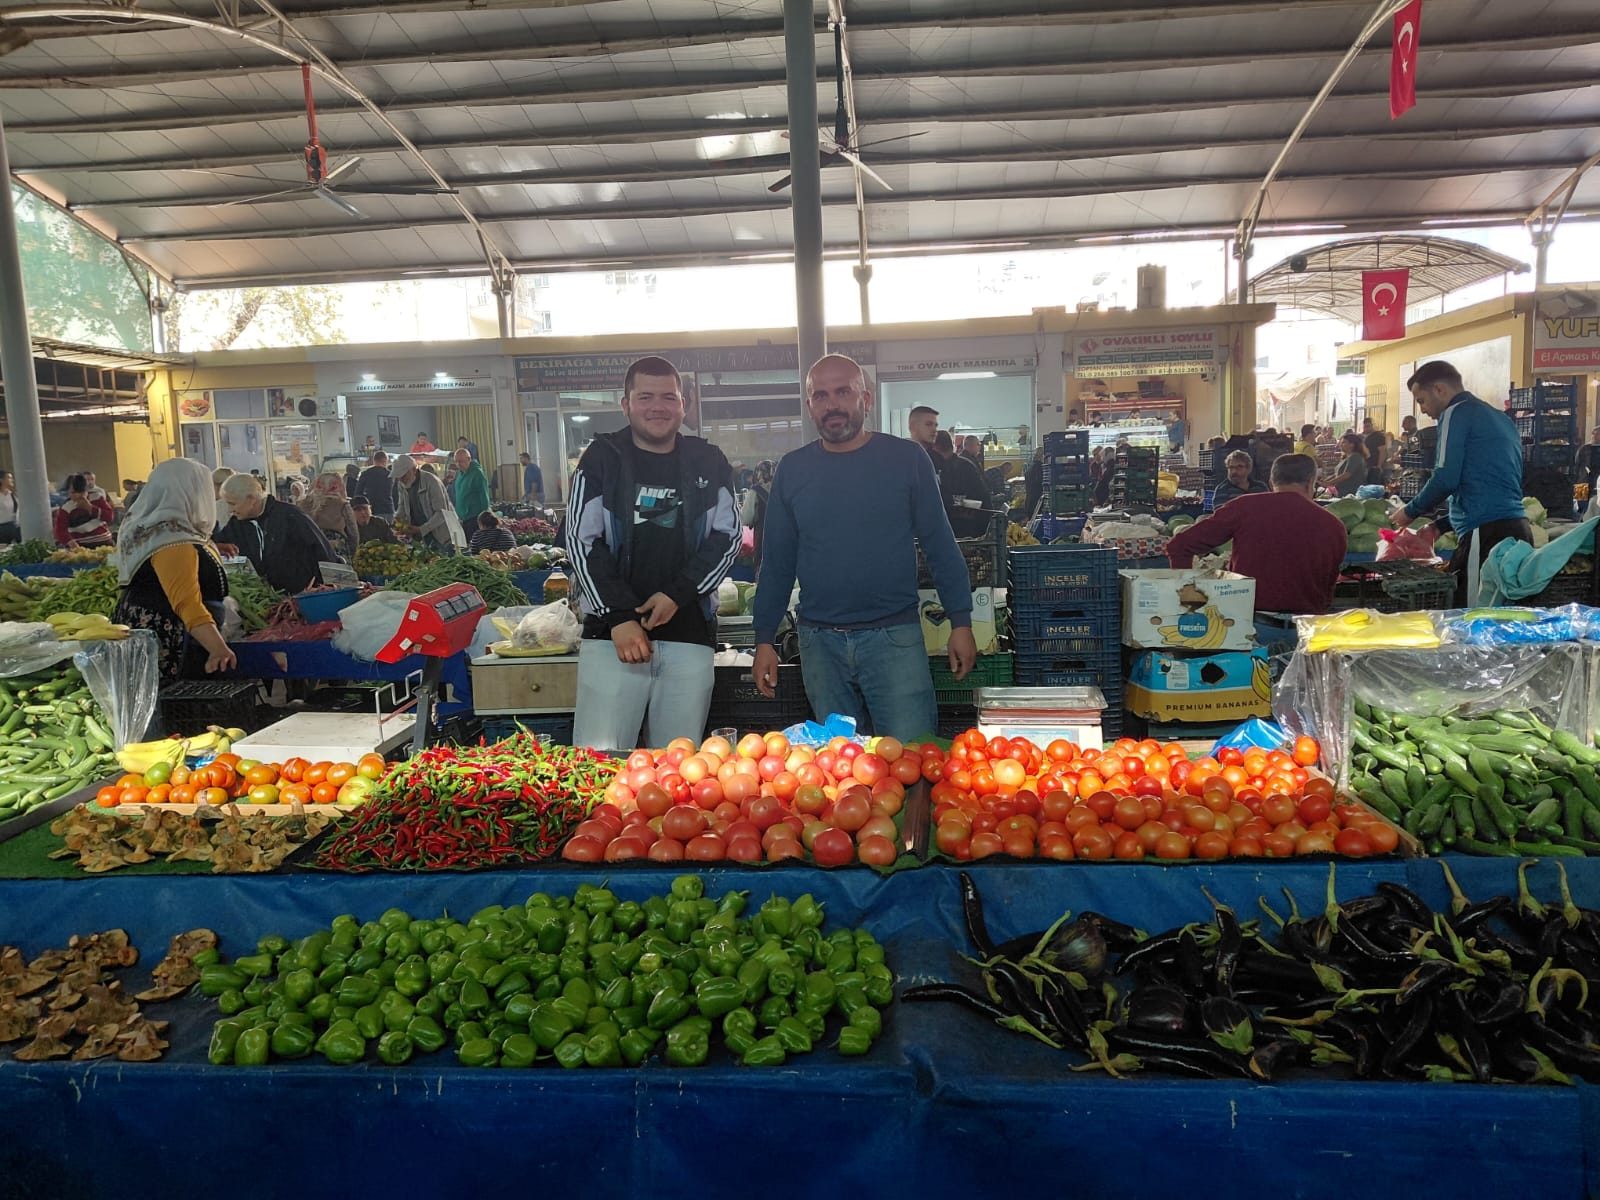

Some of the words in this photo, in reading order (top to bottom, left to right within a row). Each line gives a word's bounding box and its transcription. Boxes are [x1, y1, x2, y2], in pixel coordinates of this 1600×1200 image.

[1544, 316, 1600, 339] YUF
[1552, 351, 1590, 364] Açması
[1219, 588, 1250, 597] bananas
[1166, 703, 1212, 711] PREMIUM
[1216, 699, 1260, 710] BANANAS
